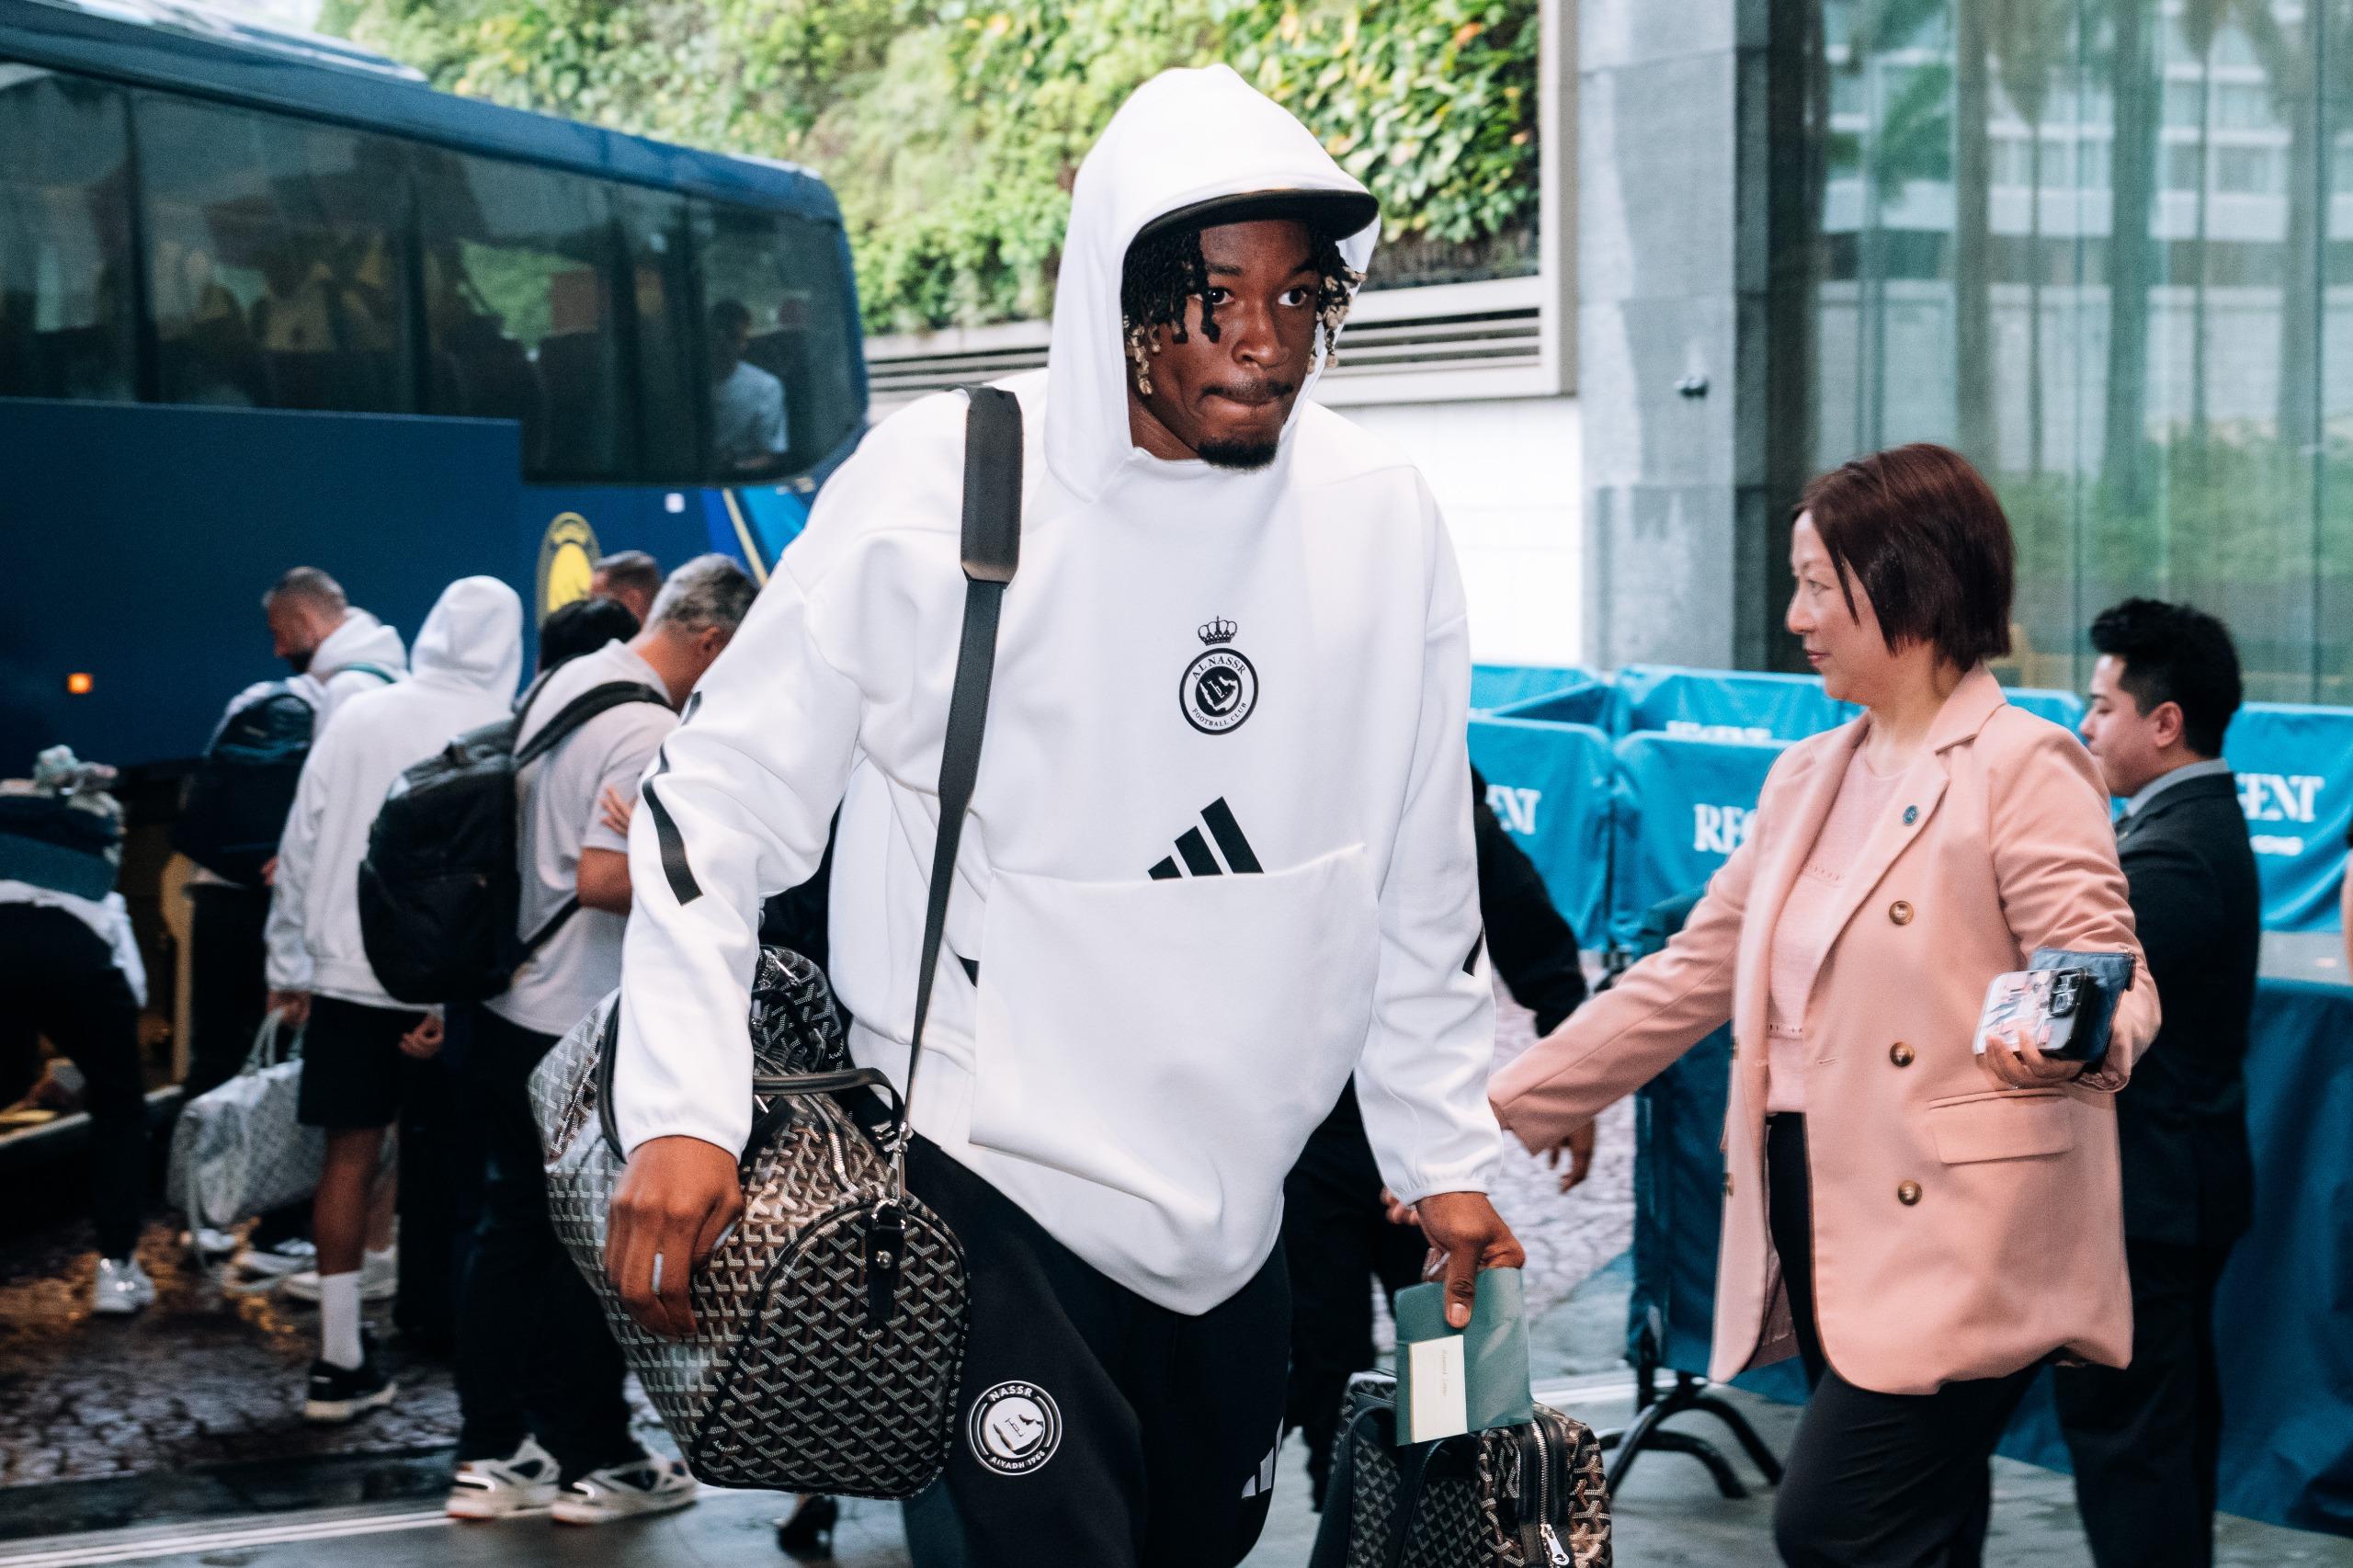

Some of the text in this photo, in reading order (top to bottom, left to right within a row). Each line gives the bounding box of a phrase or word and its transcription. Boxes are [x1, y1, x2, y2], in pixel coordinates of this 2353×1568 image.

[1208, 655, 1246, 676] NASSR
[1192, 702, 1246, 727] FOOTBALL CLUB
[2234, 772, 2325, 824] ENT
[988, 1385, 1033, 1402] NASSR
[990, 1456, 1025, 1470] RIYADH
